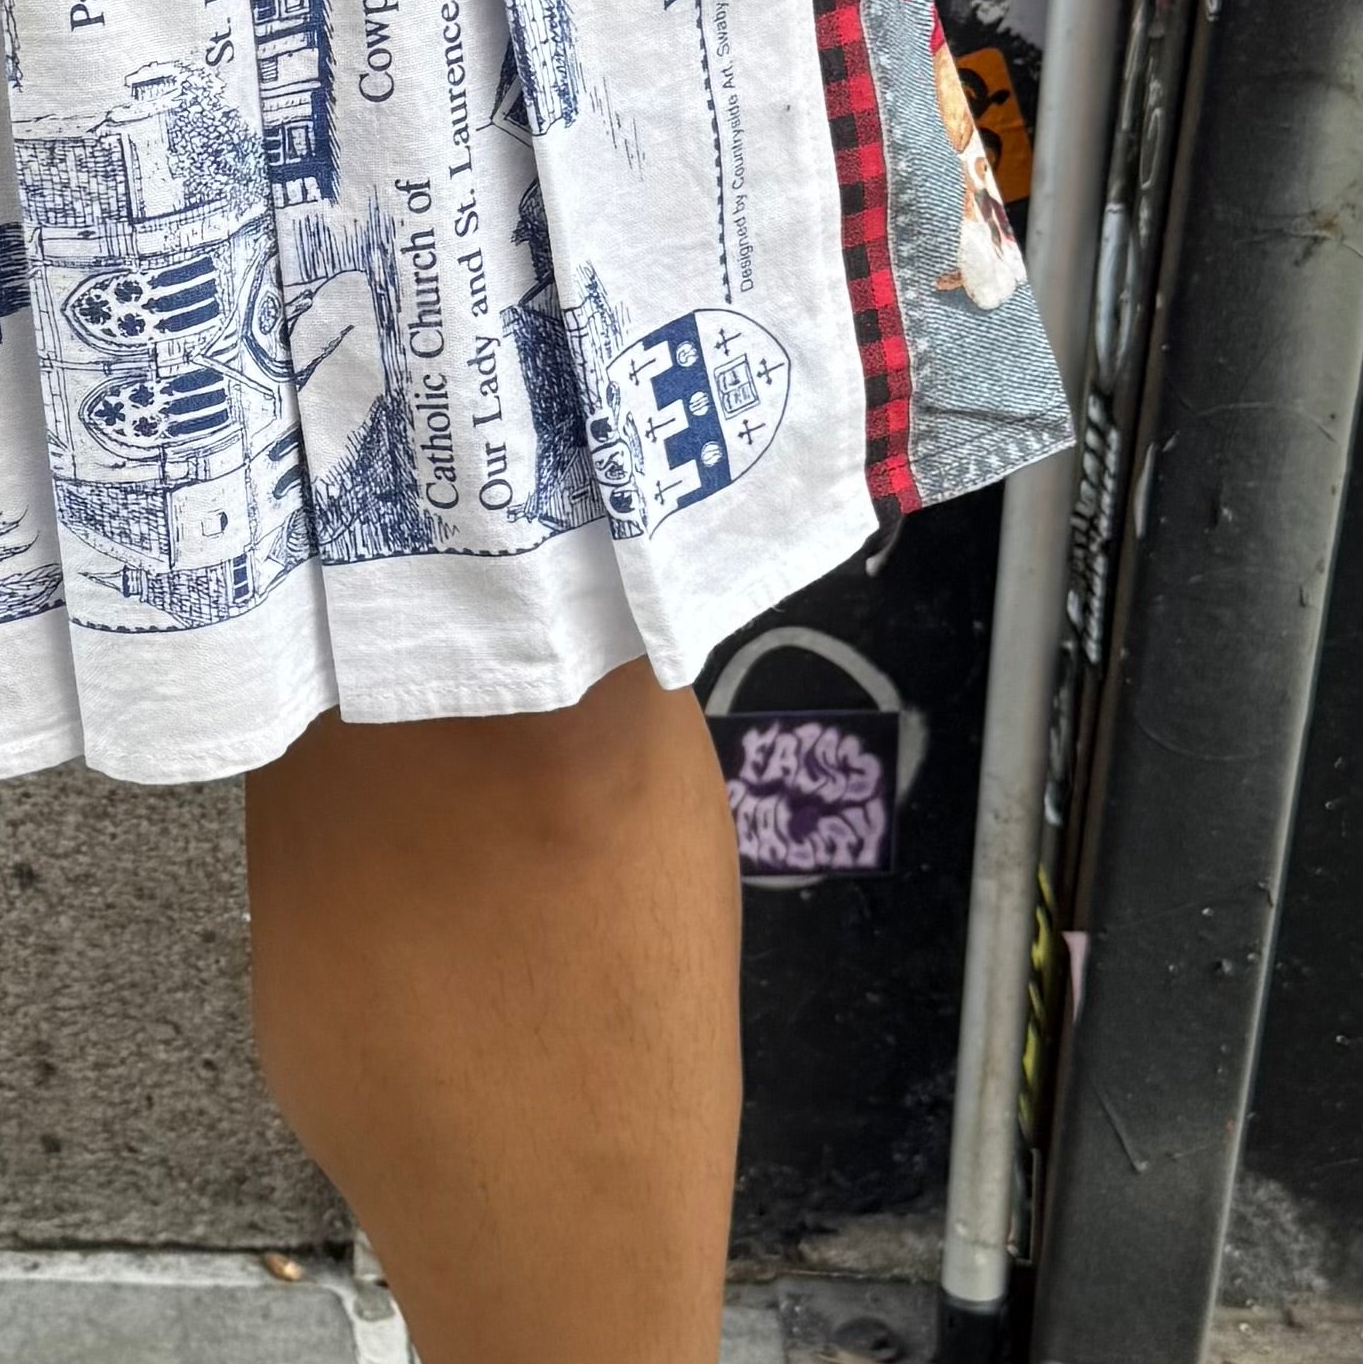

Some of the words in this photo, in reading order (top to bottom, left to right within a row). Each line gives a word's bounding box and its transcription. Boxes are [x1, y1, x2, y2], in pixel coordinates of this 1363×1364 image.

[205, 18, 235, 68] St.
[726, 94, 747, 191] Countryside
[395, 178, 432, 214] of
[448, 189, 481, 243] St.
[732, 194, 749, 215] by
[459, 250, 487, 319] and
[734, 216, 756, 293] Designed
[402, 229, 446, 360] Church
[474, 336, 503, 430] Lady
[409, 374, 460, 510] Catholic
[474, 440, 514, 511] Our
